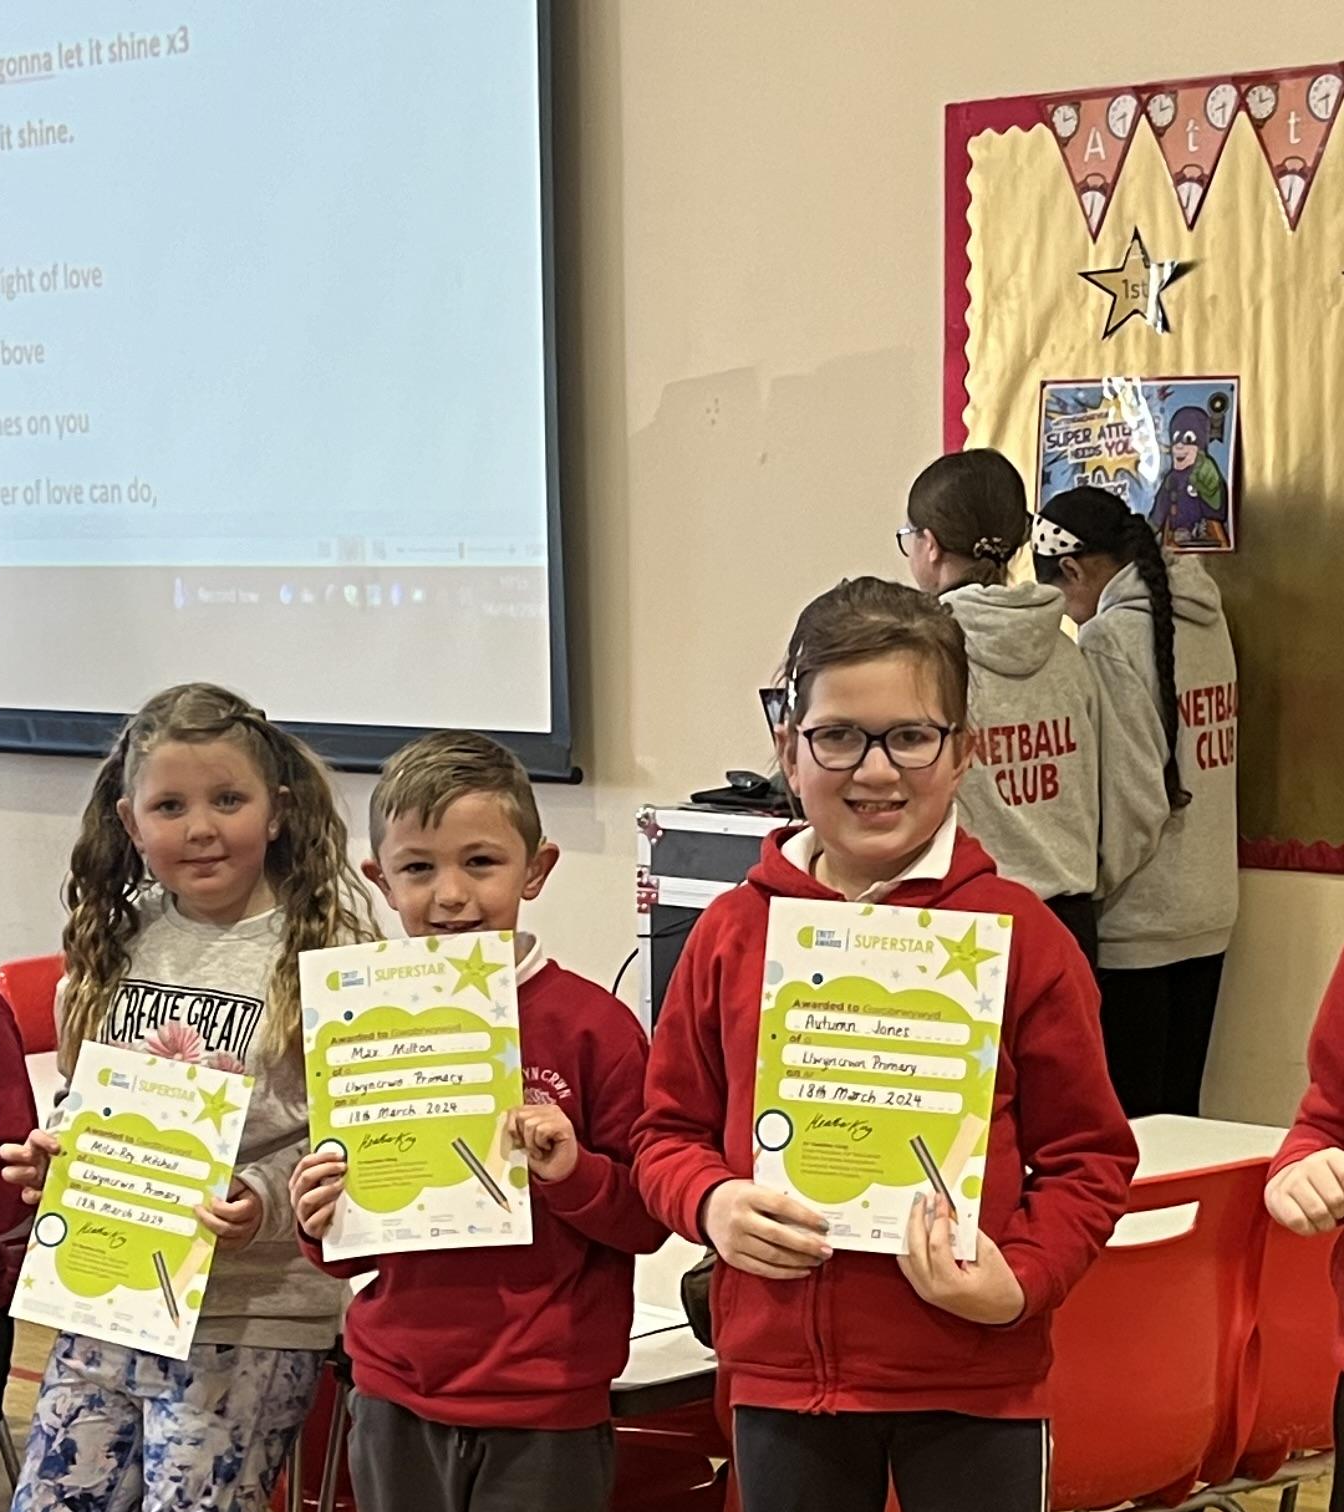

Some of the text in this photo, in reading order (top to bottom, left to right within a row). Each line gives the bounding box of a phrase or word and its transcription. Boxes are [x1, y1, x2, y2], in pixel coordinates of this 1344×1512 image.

[59, 43, 83, 70] let
[89, 40, 102, 65] it
[108, 33, 161, 62] shine
[166, 26, 189, 54] x3
[0, 124, 13, 150] it
[17, 119, 74, 147] shine.
[40, 264, 58, 292] of
[63, 263, 103, 289] love
[1122, 279, 1149, 299] 1st
[27, 413, 50, 435] on
[55, 412, 89, 440] you
[1047, 428, 1092, 449] SUPER
[23, 478, 41, 505] of
[46, 477, 84, 505] love
[89, 481, 121, 505] can
[127, 477, 157, 508] do,
[1179, 682, 1237, 728] NETBA
[969, 716, 1077, 768] NETBALL
[995, 763, 1060, 807] CLUB
[854, 934, 934, 953] SUPERSTAR
[374, 963, 446, 982] SUPERSTAR
[792, 998, 844, 1012] Awarded
[848, 1003, 859, 1012] to
[111, 986, 253, 1054] CREATE GREAT
[805, 1014, 910, 1038] Autumn Jones
[789, 1033, 802, 1043] of
[351, 1047, 379, 1059] Max
[139, 1079, 195, 1102] SUPERSTAR
[799, 1084, 922, 1107] 18th March 2024
[377, 1104, 416, 1120] March
[427, 1102, 457, 1115] 2024
